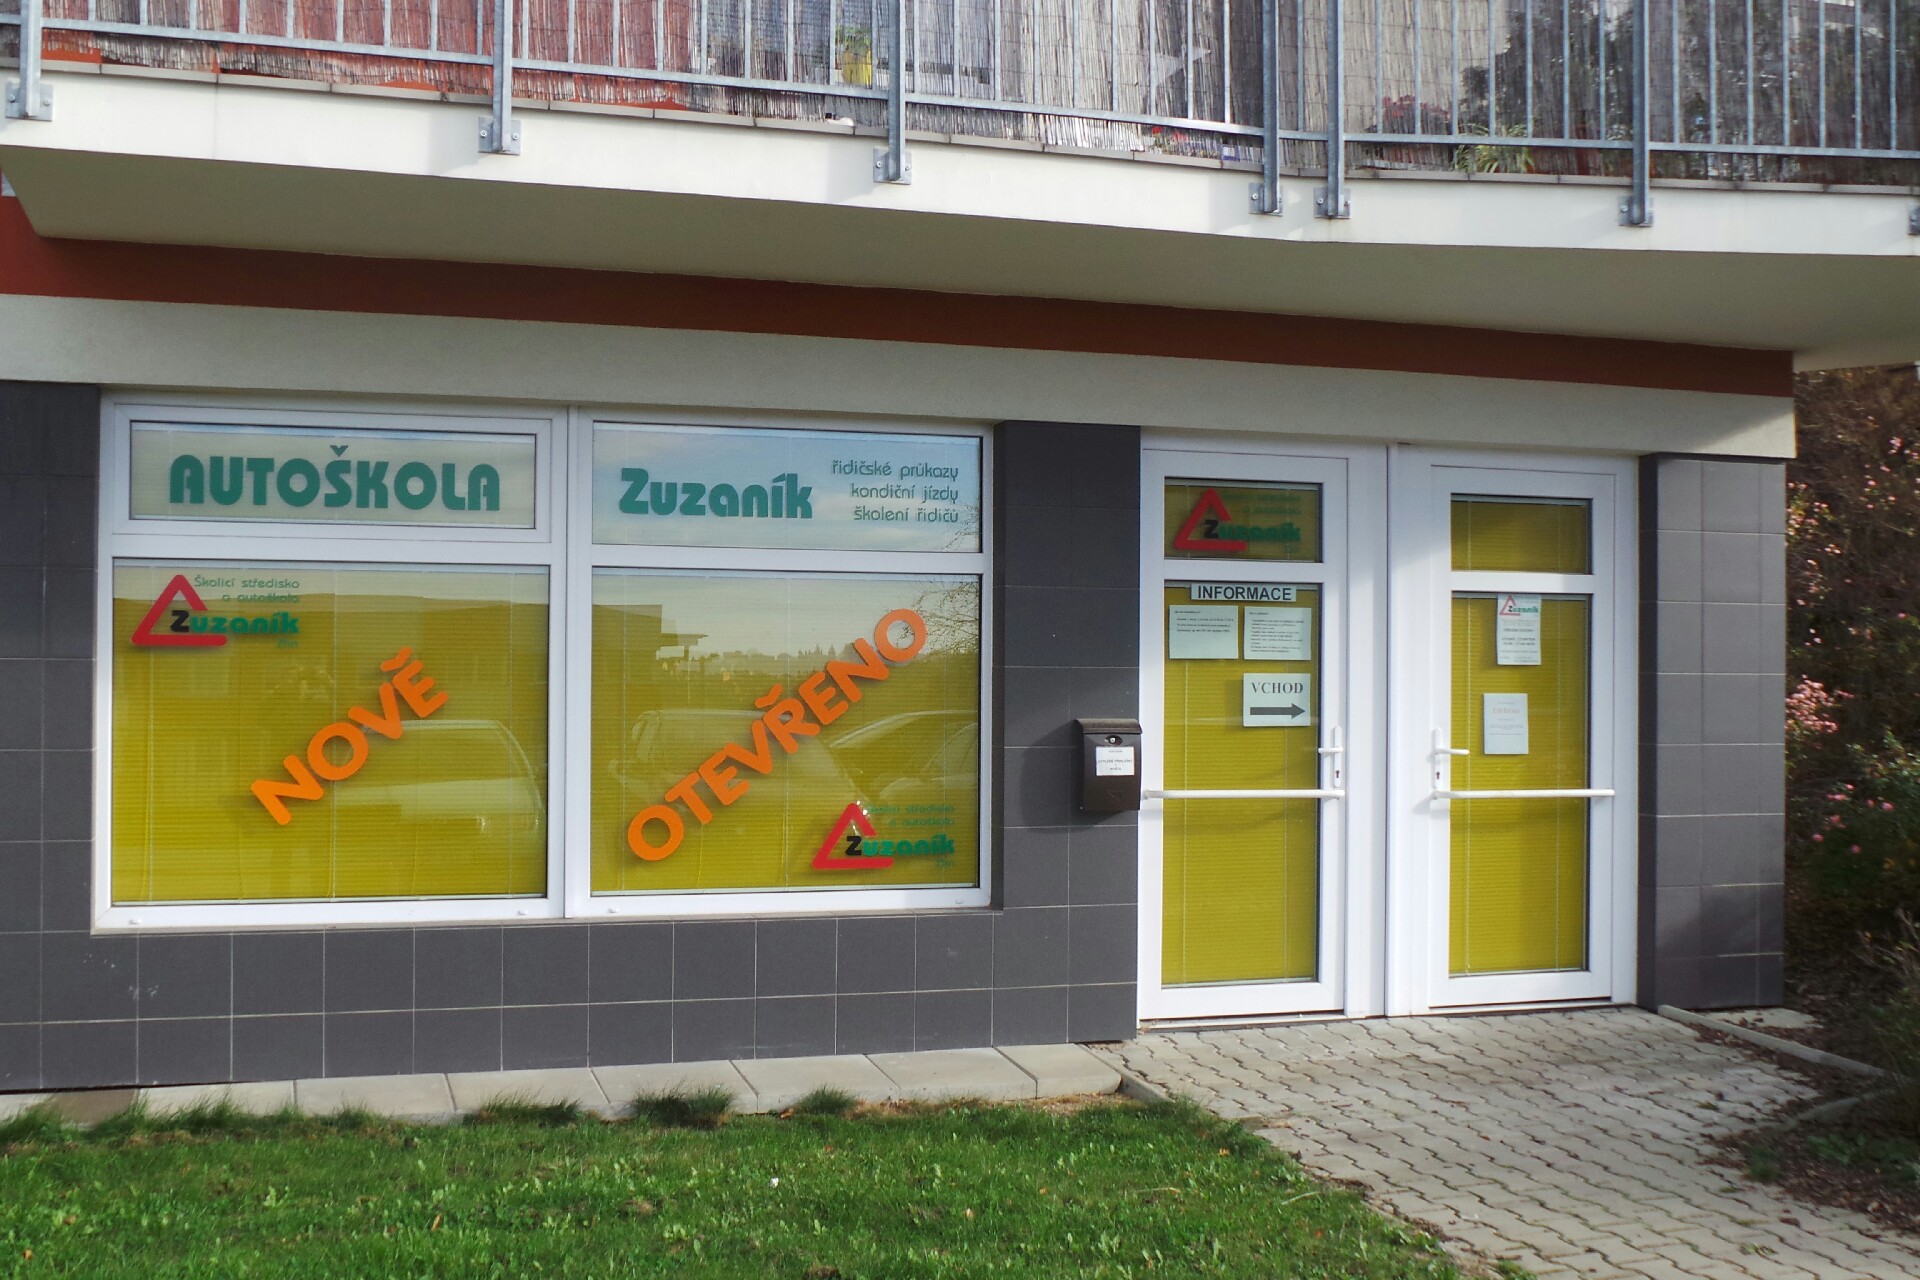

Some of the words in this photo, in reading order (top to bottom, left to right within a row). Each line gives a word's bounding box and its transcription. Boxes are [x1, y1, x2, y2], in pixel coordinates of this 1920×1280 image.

[169, 444, 500, 512] AUTOŠKOLA
[832, 459, 892, 476] řidičské
[899, 462, 959, 482] průkazy
[618, 467, 813, 519] Zuzaník
[850, 482, 916, 499] kondiční
[922, 484, 959, 504] jízdy
[853, 505, 909, 521] školení
[917, 506, 959, 523] řidičů
[241, 576, 300, 589] středisko
[1197, 585, 1292, 601] INFORMACE
[170, 609, 299, 634] Zuzaník
[1250, 682, 1304, 694] VCHOD
[250, 646, 449, 826] NOVĚ
[627, 608, 928, 861] OTEVŘENO
